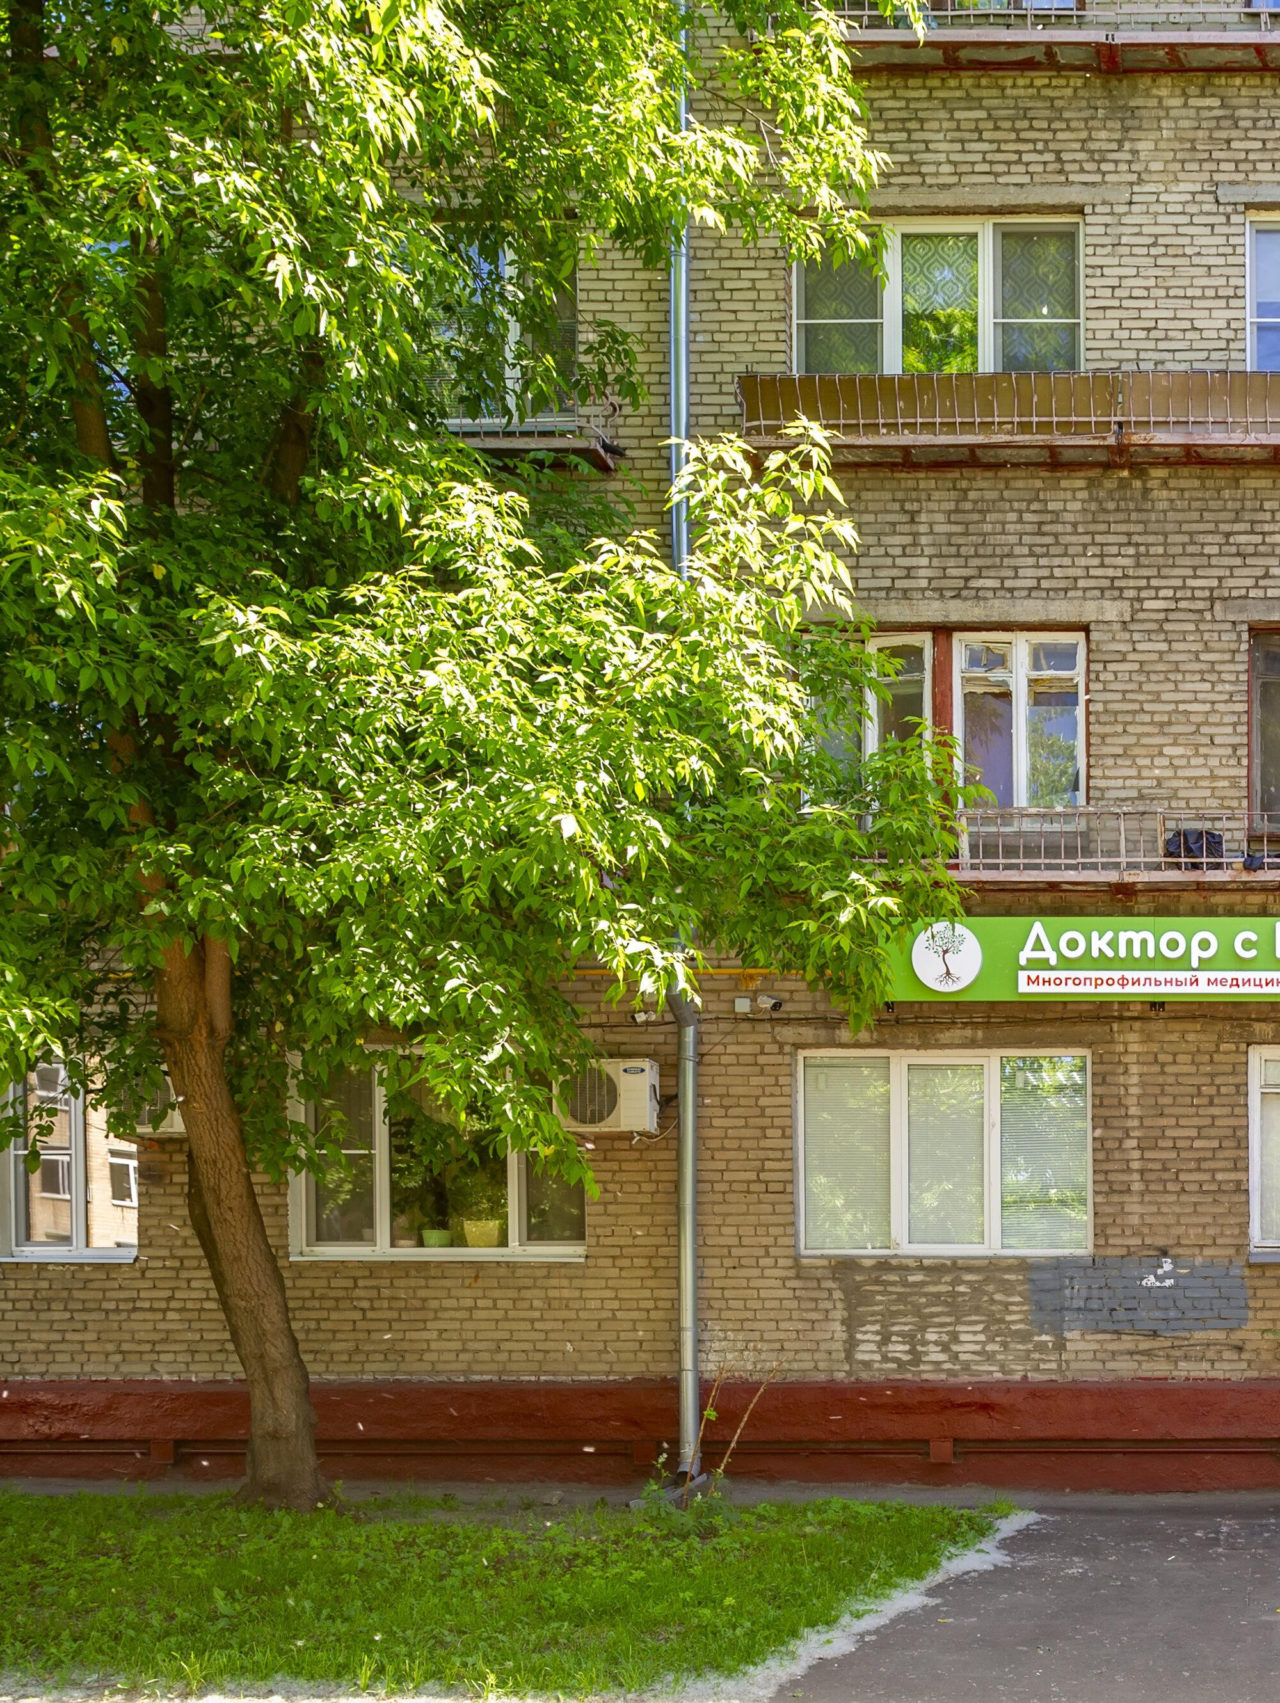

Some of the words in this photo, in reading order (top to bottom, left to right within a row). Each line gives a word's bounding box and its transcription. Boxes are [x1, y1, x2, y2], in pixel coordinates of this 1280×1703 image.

[1018, 920, 1219, 969] Доктор
[1234, 930, 1259, 959] с
[1026, 973, 1200, 990] Многопрофильный
